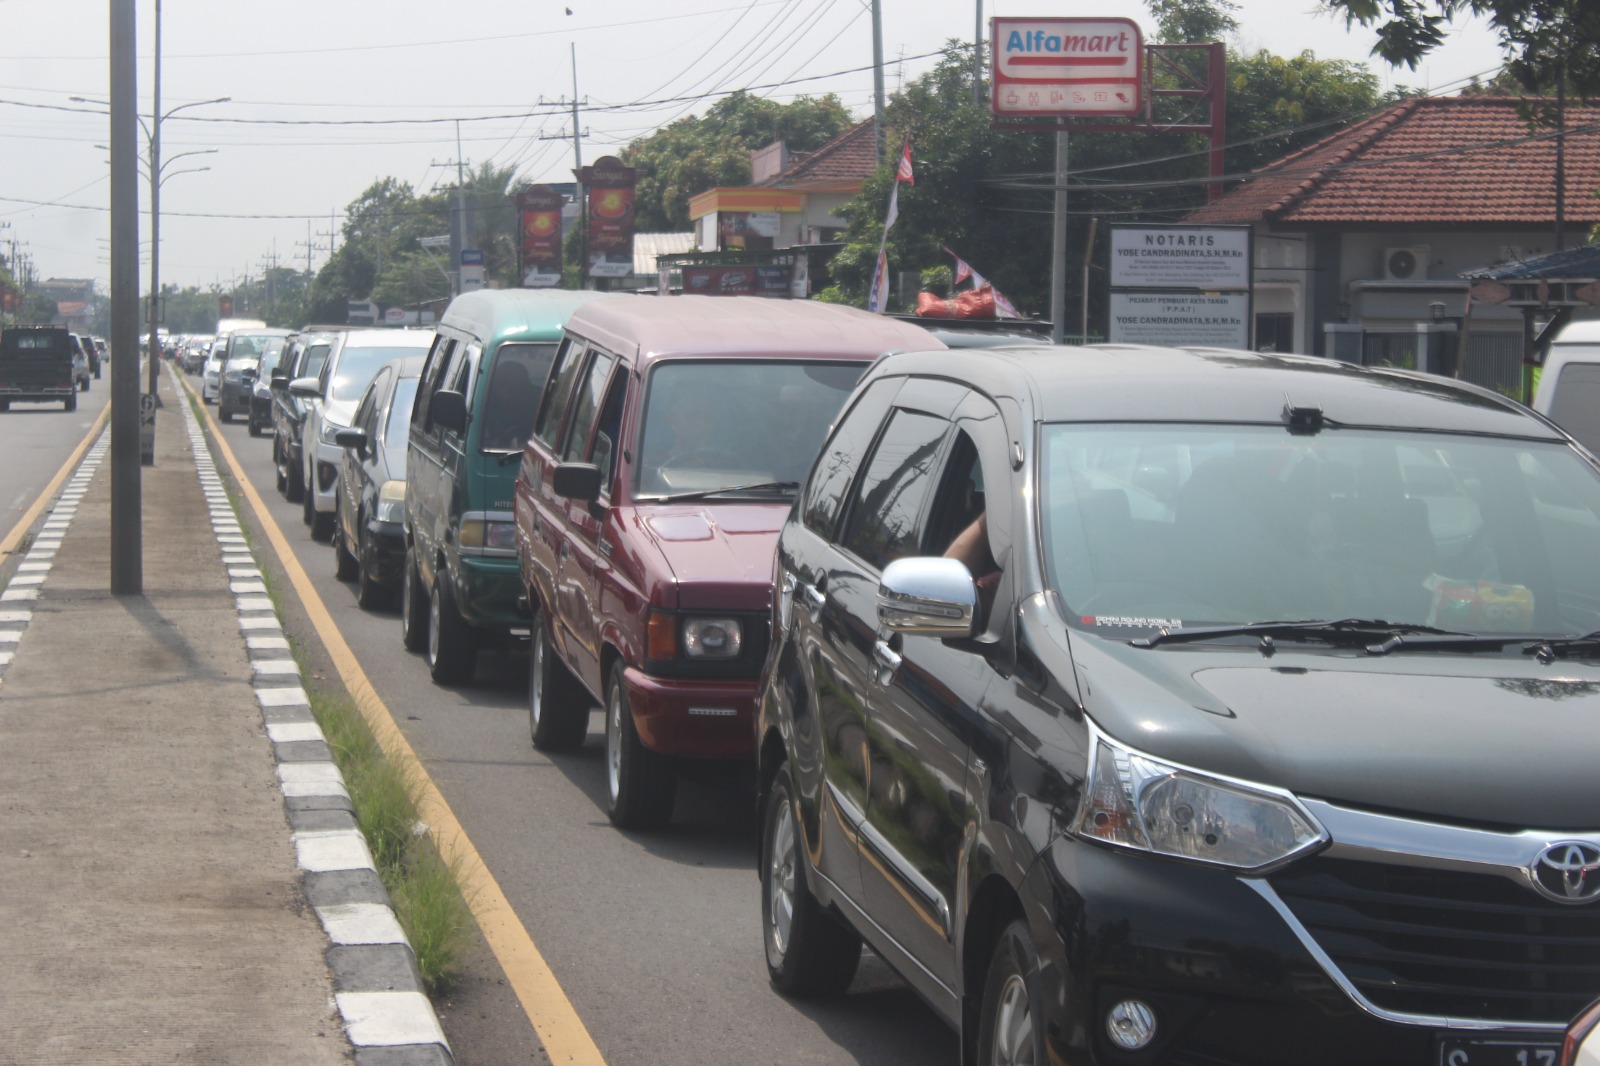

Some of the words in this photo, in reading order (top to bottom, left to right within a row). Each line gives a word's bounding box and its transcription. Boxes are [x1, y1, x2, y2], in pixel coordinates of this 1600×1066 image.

[1006, 30, 1129, 53] Alfamart
[1145, 234, 1215, 246] NOTARIS
[1118, 248, 1139, 257] YOSE
[1158, 297, 1189, 305] PEMBUAT
[1117, 316, 1138, 325] YOSE
